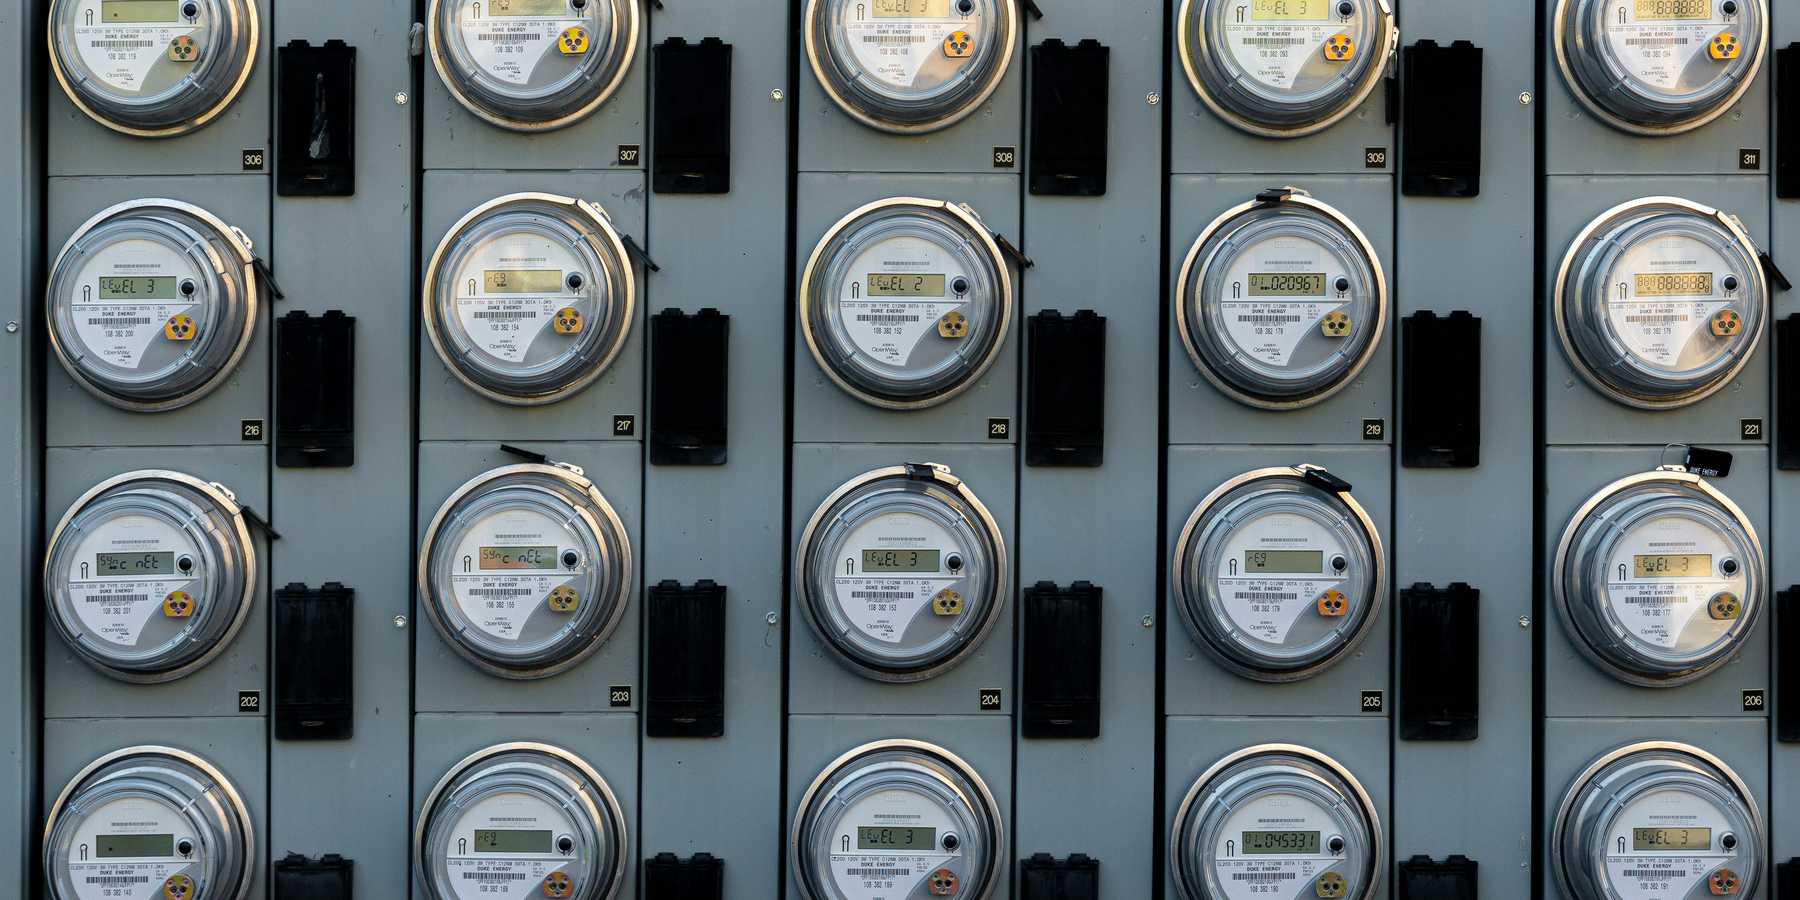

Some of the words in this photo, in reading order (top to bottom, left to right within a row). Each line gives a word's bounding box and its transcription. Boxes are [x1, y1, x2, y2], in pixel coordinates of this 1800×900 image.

[1299, 0, 1306, 15] 3
[244, 154, 262, 165] 306
[620, 150, 637, 161] 307
[995, 152, 1013, 163] 308
[1367, 152, 1385, 163] 309
[1743, 154, 1756, 164] 311
[147, 279, 155, 294] 3
[914, 276, 923, 291] 2
[1251, 276, 1264, 287] 01
[1271, 276, 1320, 291] 020967
[244, 425, 260, 435] 216
[616, 420, 631, 431] 217
[991, 423, 1006, 434] 218
[1366, 424, 1381, 435] 219
[1744, 424, 1759, 435] 221
[910, 552, 917, 566] 3
[1681, 557, 1689, 572] 3
[240, 696, 258, 707] 202
[612, 691, 629, 702] 203
[982, 694, 999, 705] 204
[1363, 696, 1381, 707] 205
[1744, 695, 1762, 706] 206
[905, 829, 913, 844] 3
[1265, 833, 1314, 848] 045331
[1681, 830, 1688, 845] 3
